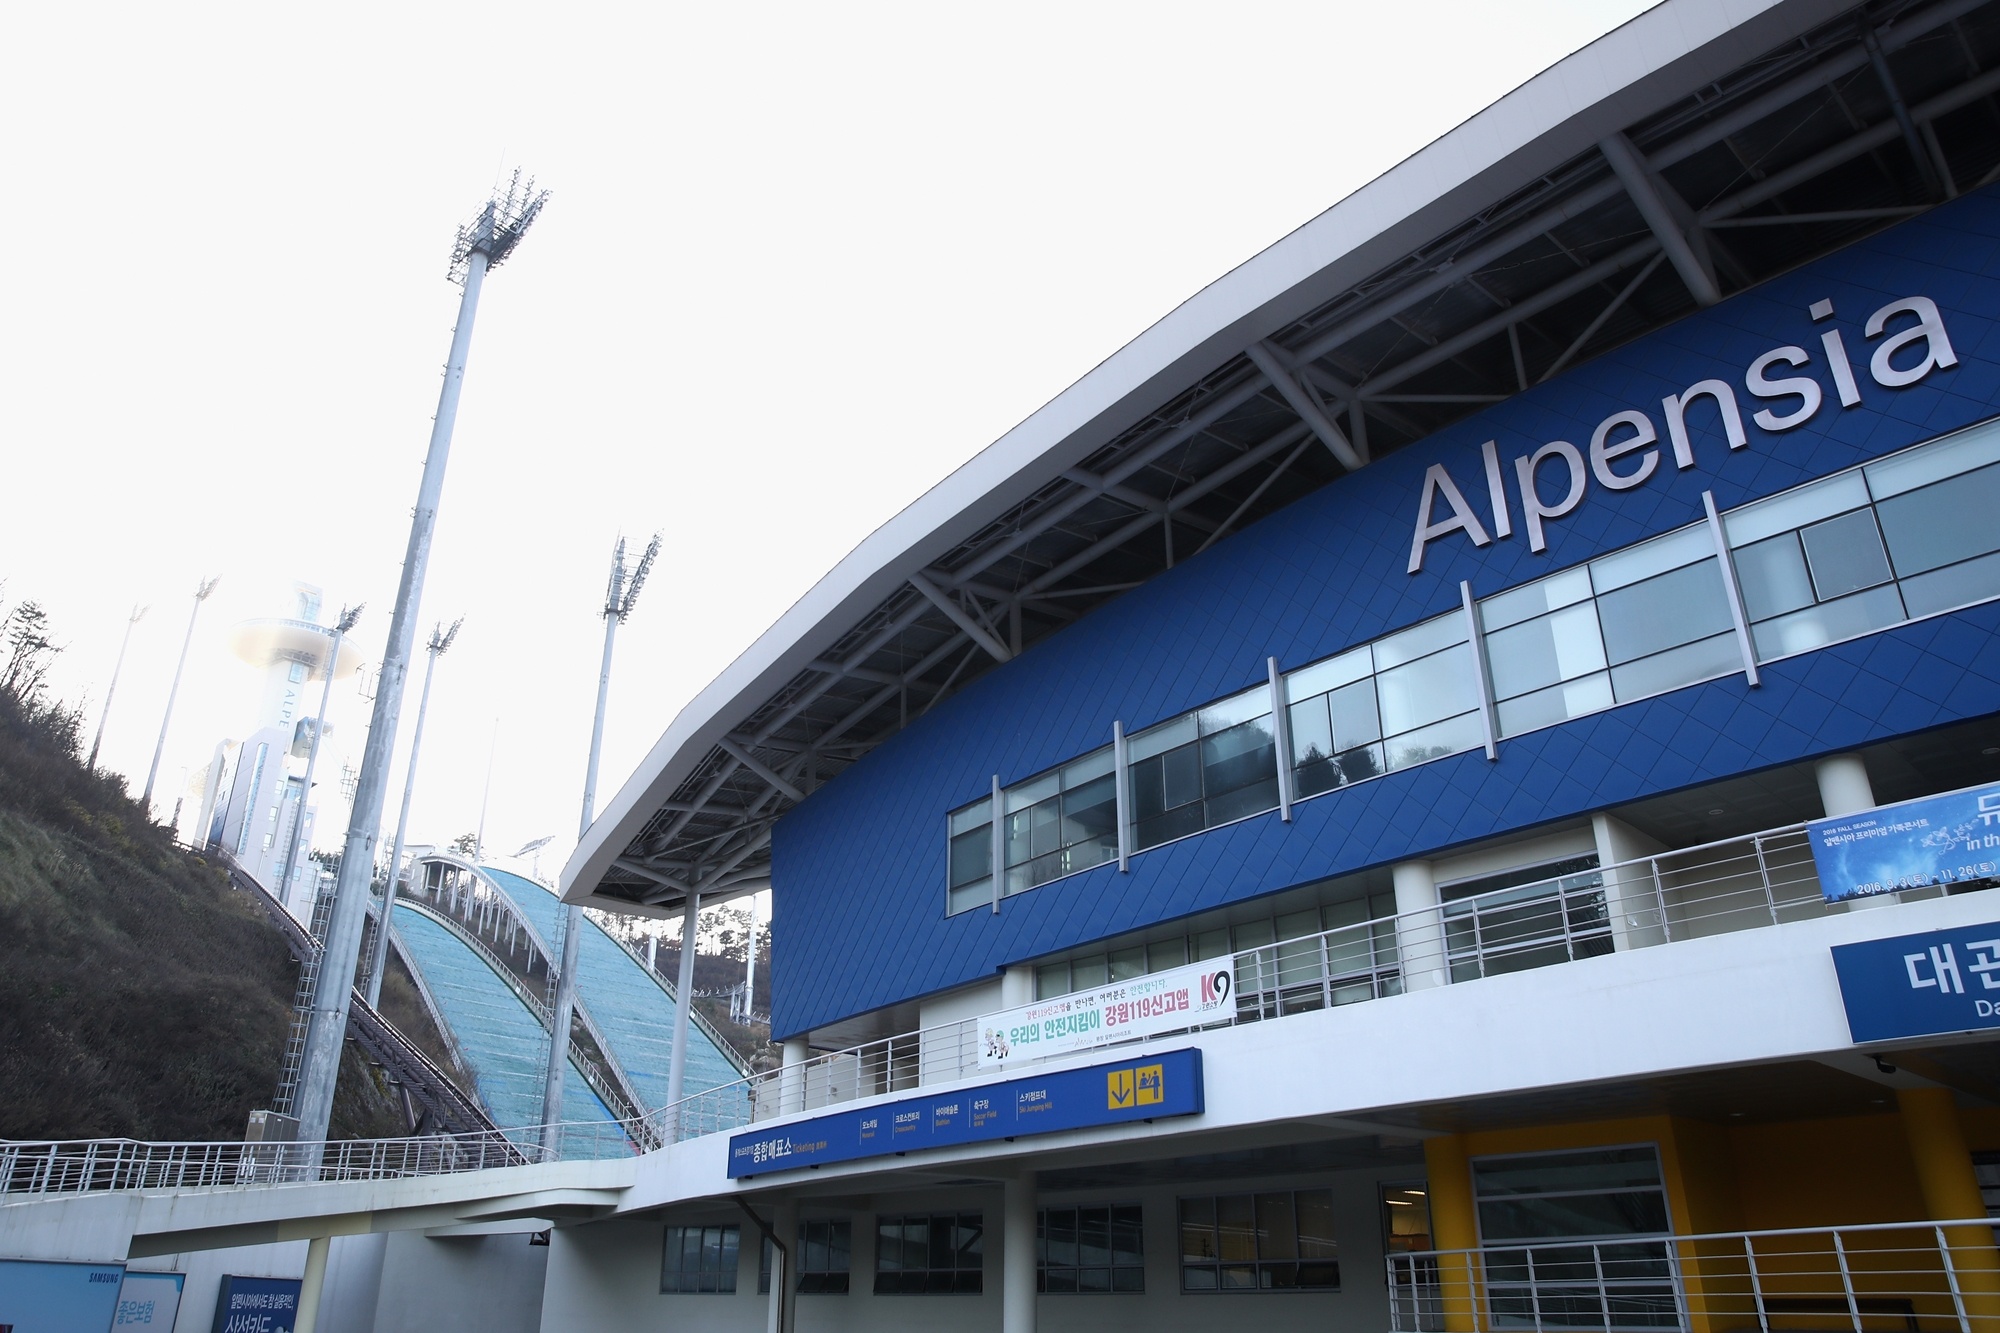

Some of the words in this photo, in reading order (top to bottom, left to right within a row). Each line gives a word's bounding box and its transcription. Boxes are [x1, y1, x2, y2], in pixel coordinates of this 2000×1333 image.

[1407, 296, 1959, 574] Alpensia
[1823, 832, 1856, 847] 알펜시아
[1856, 826, 1888, 840] 프리미엄
[1888, 818, 1930, 834] 가족콘서트
[1837, 825, 1852, 834] FALL
[1853, 820, 1877, 830] SEASON
[1966, 837, 1981, 851] in
[1857, 881, 1885, 895] 2016.
[1958, 860, 1997, 877] 26(토)
[1010, 1021, 1040, 1047] 우리의
[1044, 1009, 1100, 1040] 안전지킴이
[1105, 987, 1190, 1027] 강원119신고앱
[1019, 1089, 1046, 1103] 스키점프대
[974, 1099, 989, 1111] 축구장
[753, 1137, 792, 1163] 종합매표소
[793, 1141, 815, 1154] Ticketing
[89, 1272, 119, 1284] SAMSUNG
[231, 1293, 269, 1309] 알펜시아에서도
[268, 1293, 274, 1309] 참
